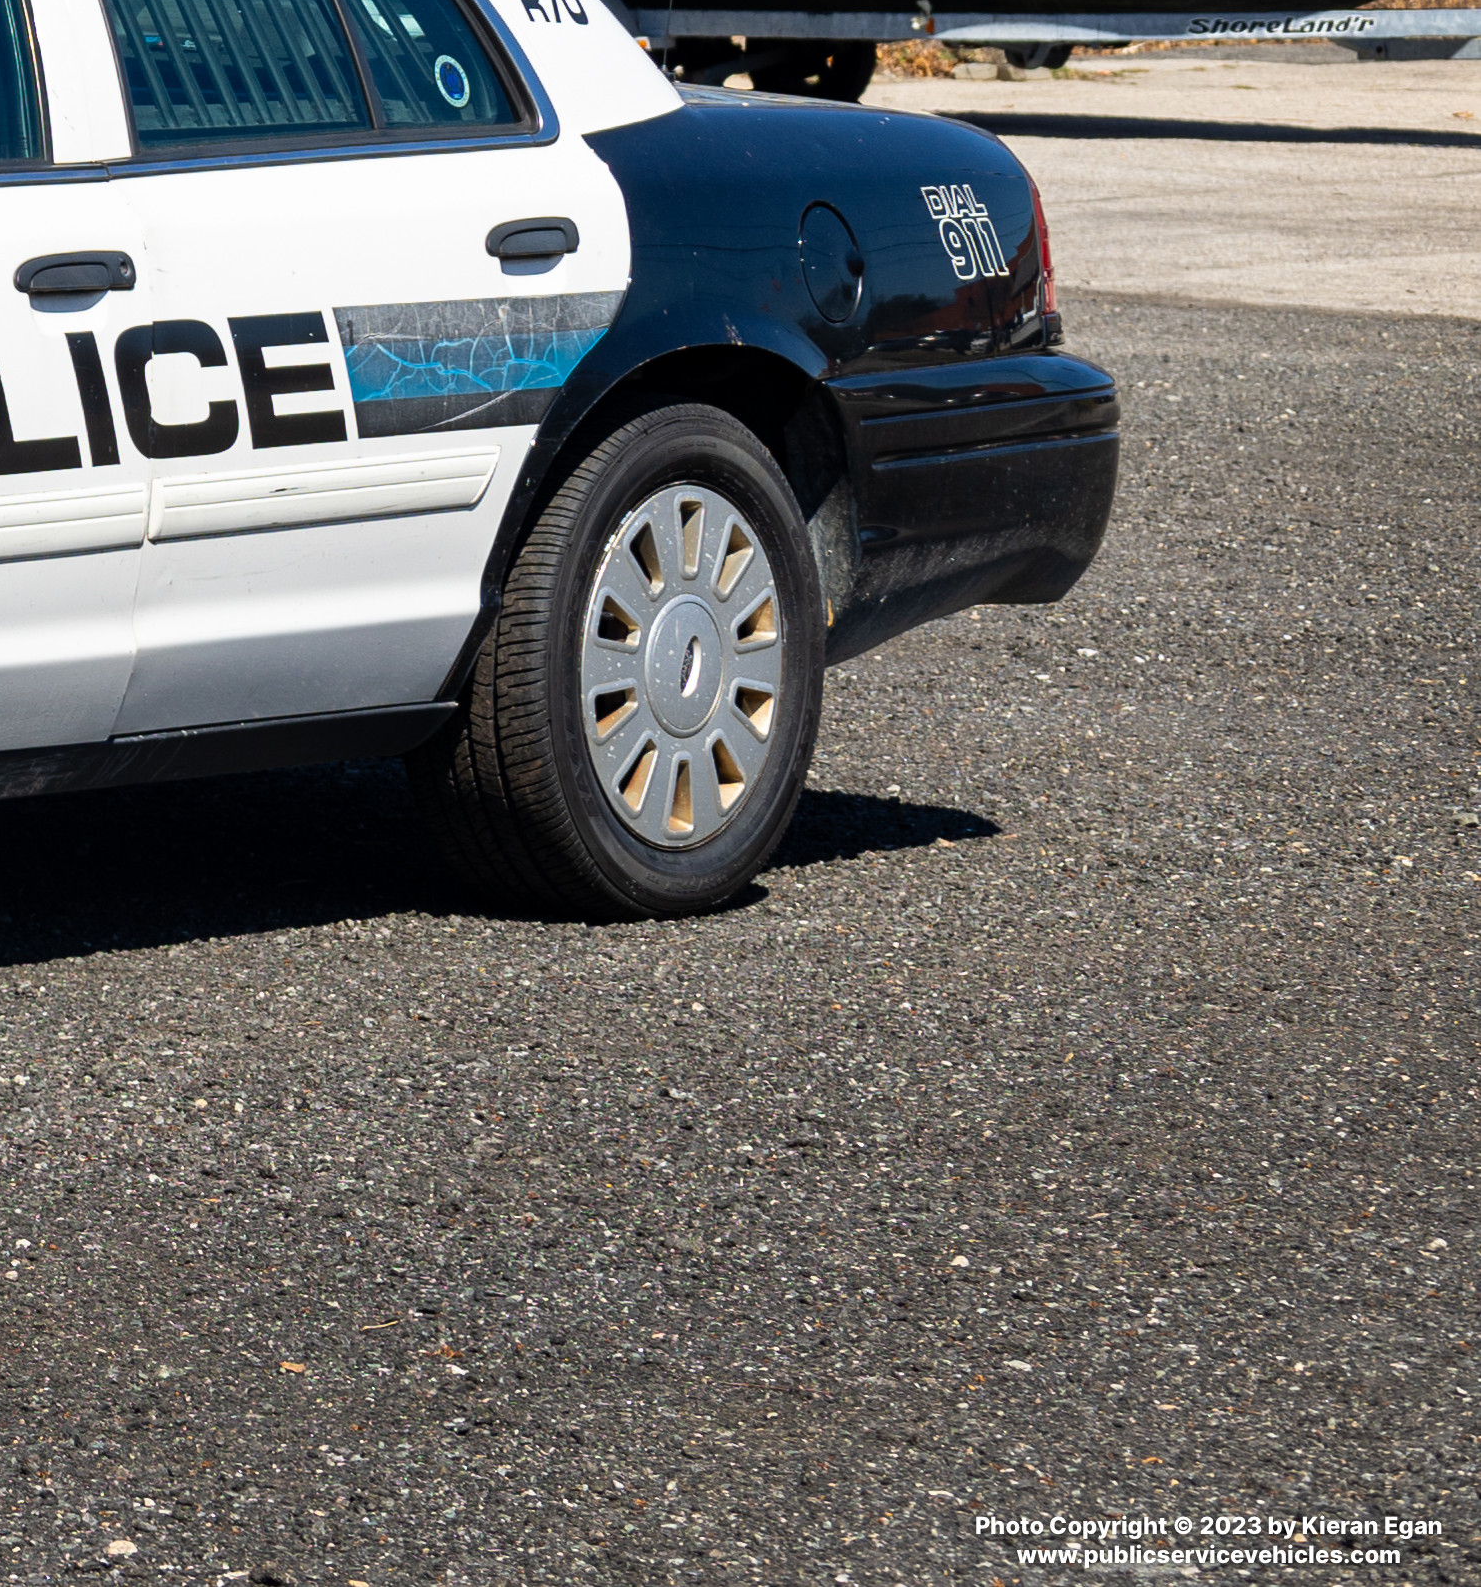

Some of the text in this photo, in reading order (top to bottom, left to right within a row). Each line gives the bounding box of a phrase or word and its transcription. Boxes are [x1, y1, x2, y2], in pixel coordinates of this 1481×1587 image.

[1187, 15, 1375, 35] ShoreLand'r
[920, 184, 989, 219] DIAL
[939, 217, 1010, 281] 911
